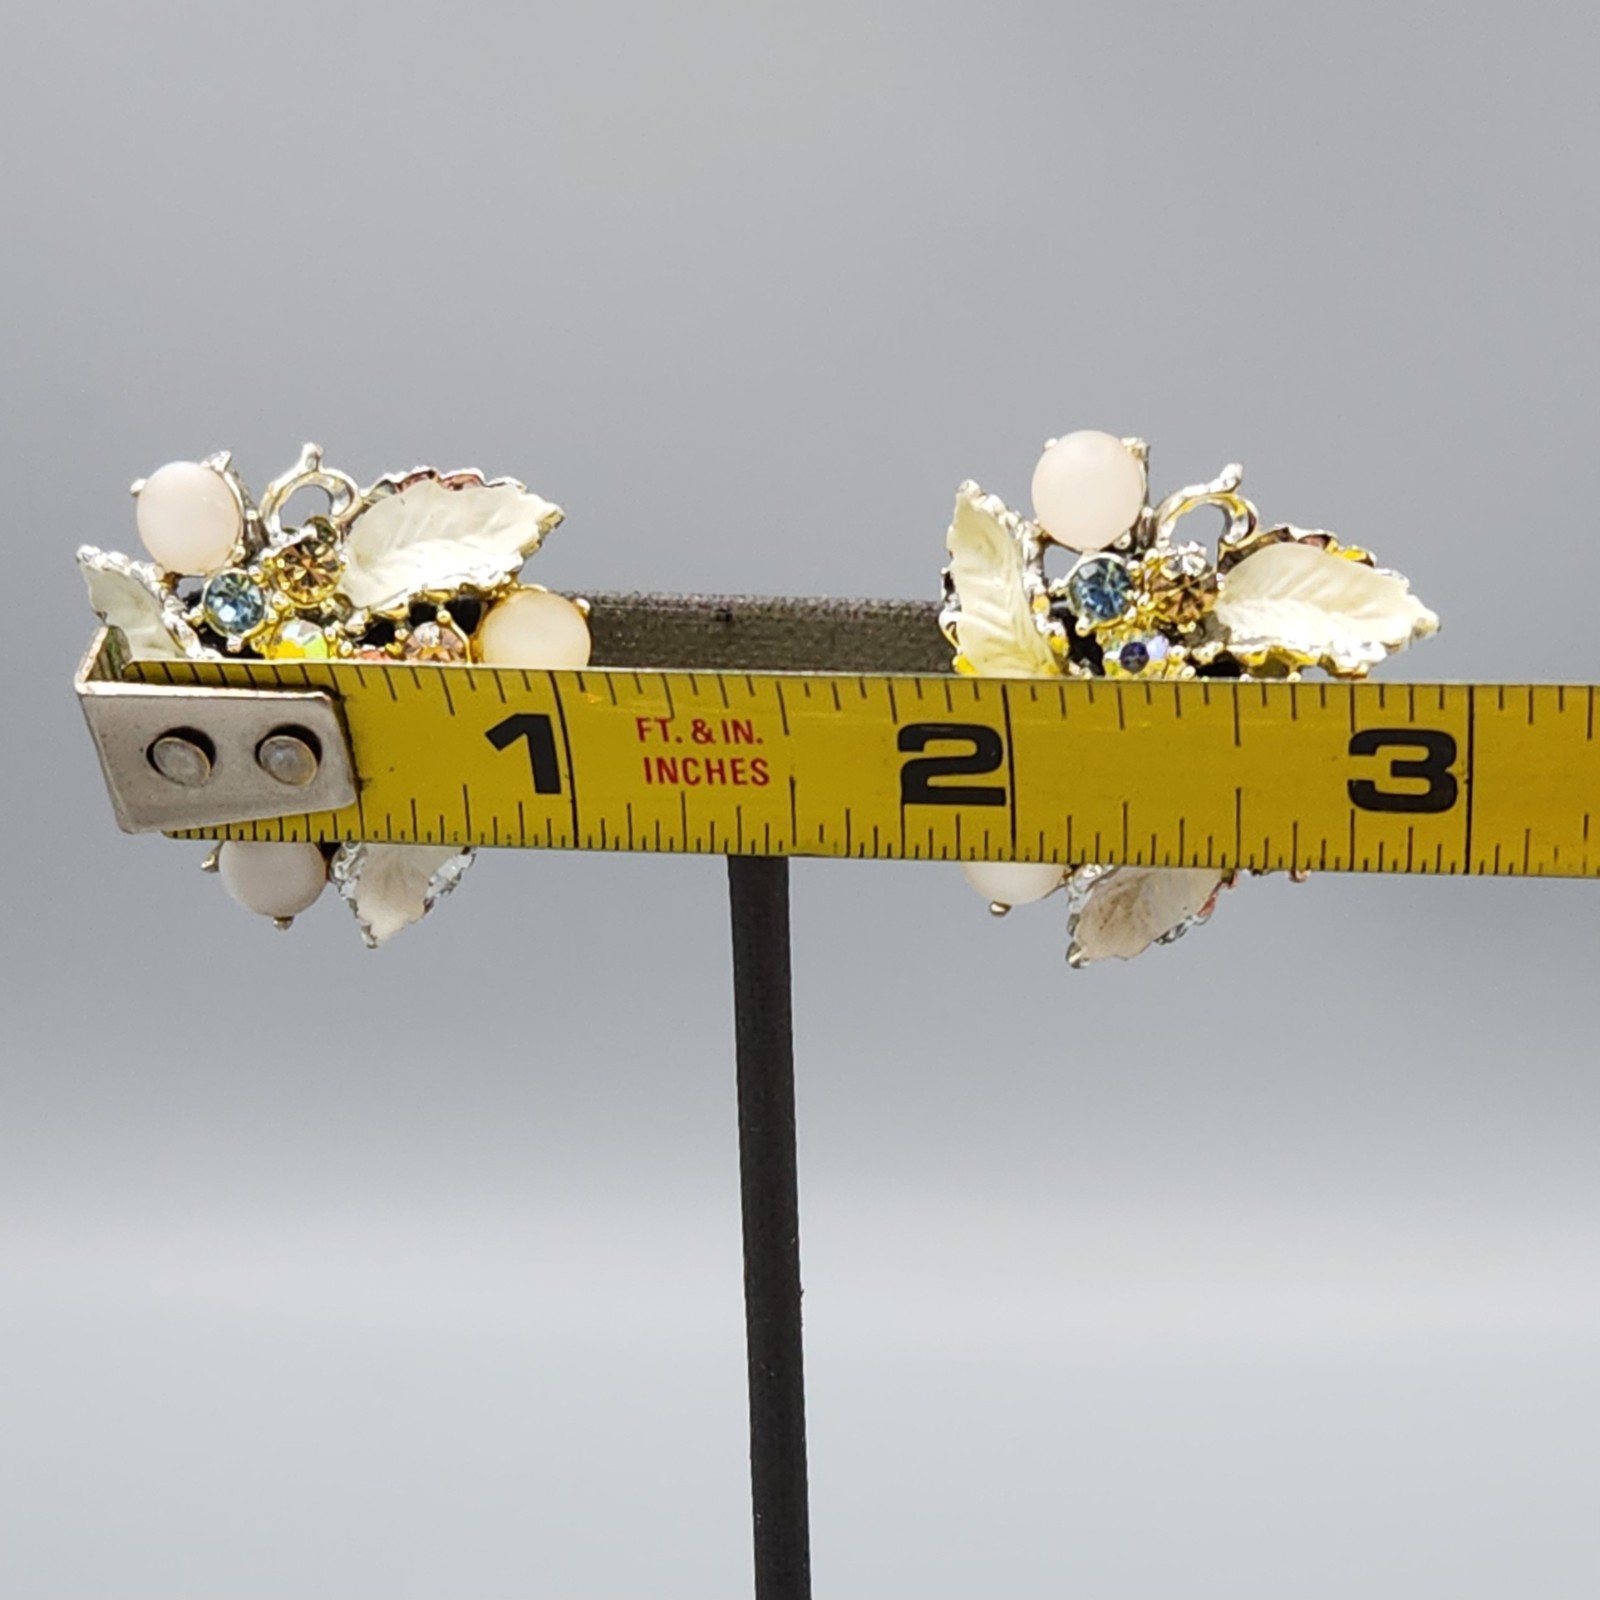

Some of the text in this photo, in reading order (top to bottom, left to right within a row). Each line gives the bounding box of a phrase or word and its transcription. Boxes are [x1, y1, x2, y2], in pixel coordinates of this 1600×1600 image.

[484, 713, 562, 794] 1
[635, 716, 683, 744] FT.
[721, 719, 764, 746] IN.
[643, 756, 771, 787] INCHES
[897, 723, 1007, 807] 2
[1347, 728, 1459, 814] 3
